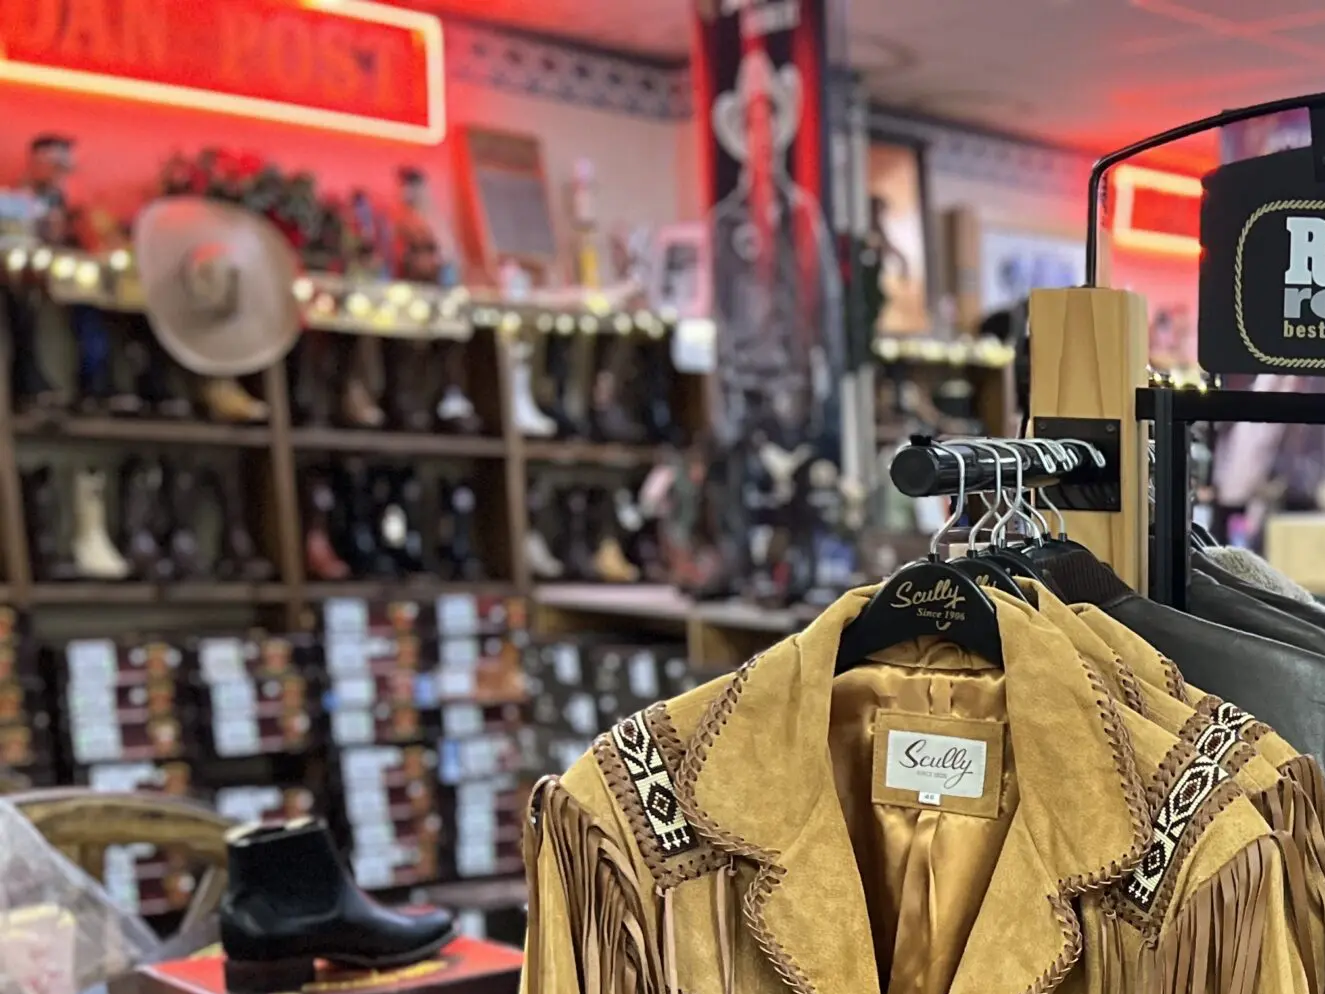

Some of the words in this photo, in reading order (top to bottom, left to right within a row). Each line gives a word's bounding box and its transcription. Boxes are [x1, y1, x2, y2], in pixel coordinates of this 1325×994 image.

[218, 9, 405, 112] POST
[1284, 321, 1325, 338] best
[890, 579, 966, 631] Scully
[916, 608, 942, 619] Since
[899, 739, 974, 790] Scully
